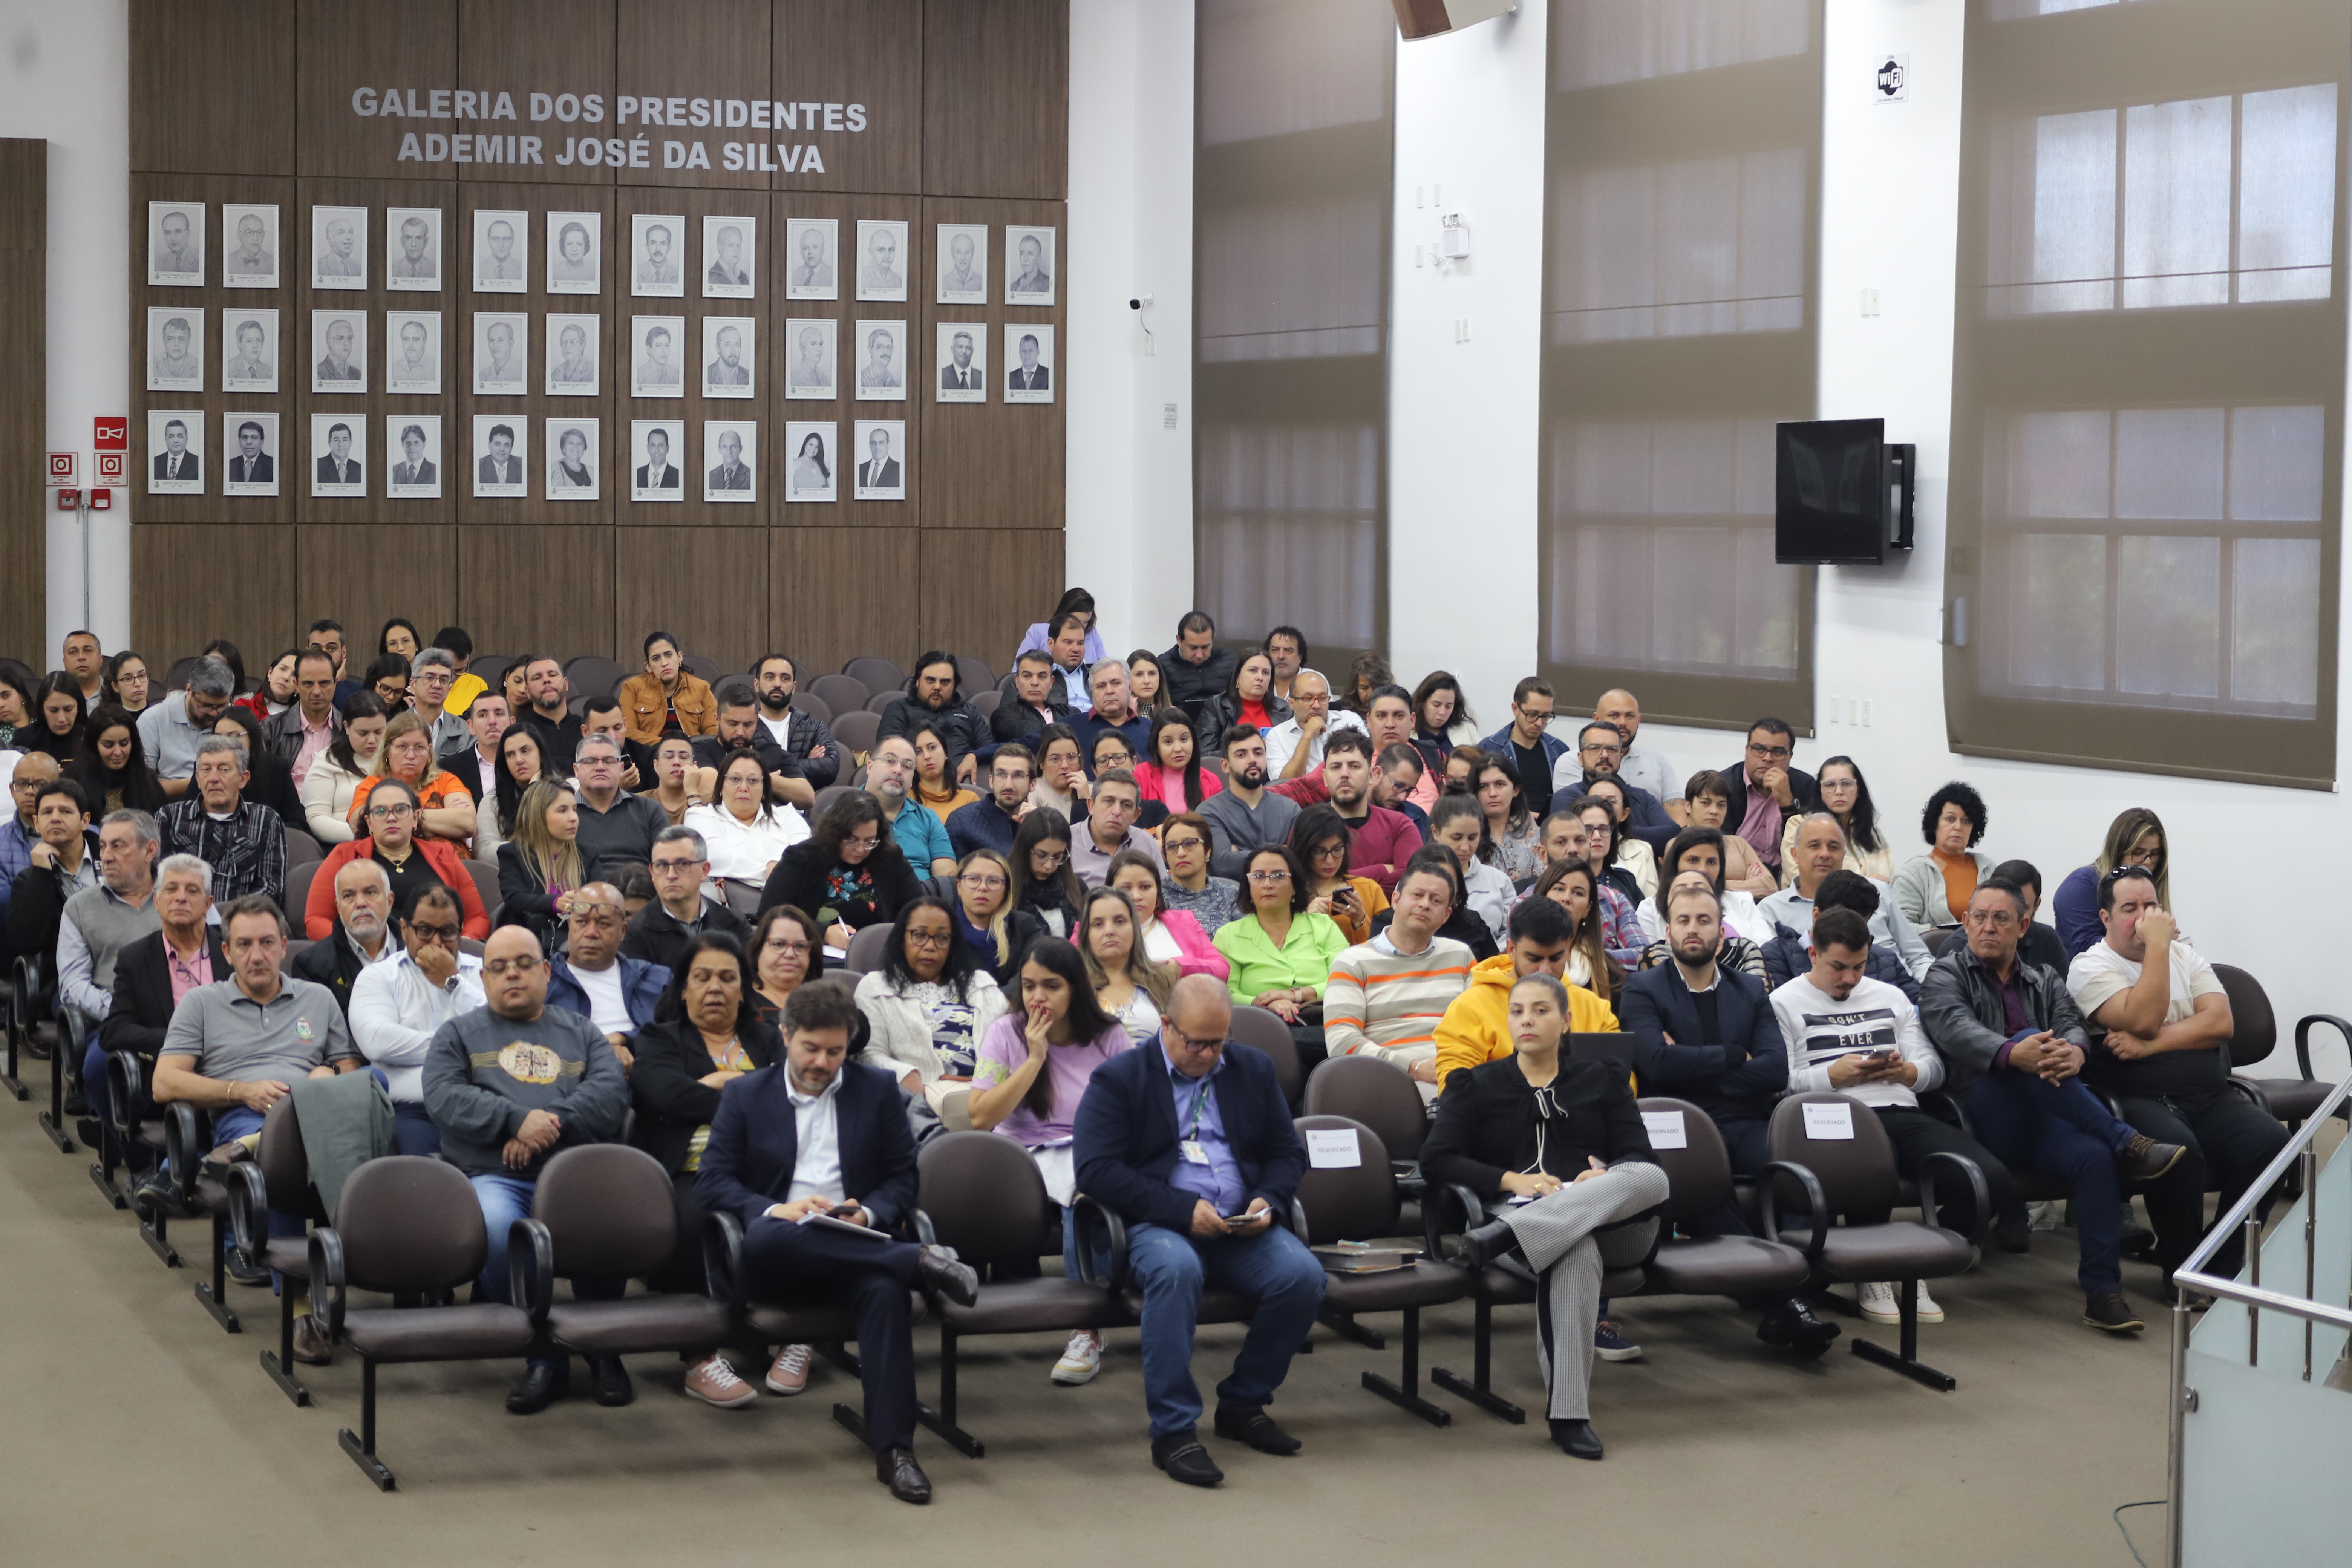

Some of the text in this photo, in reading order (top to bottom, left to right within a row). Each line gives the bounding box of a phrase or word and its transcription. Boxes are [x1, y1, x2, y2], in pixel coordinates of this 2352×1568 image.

[352, 88, 867, 132] GALERIA DOS PRESIDENTES
[398, 133, 825, 173] ADEMIR JOSÉ DA SILVA
[1828, 1013, 1865, 1024] DON'T
[1839, 1032, 1873, 1046] EVER
